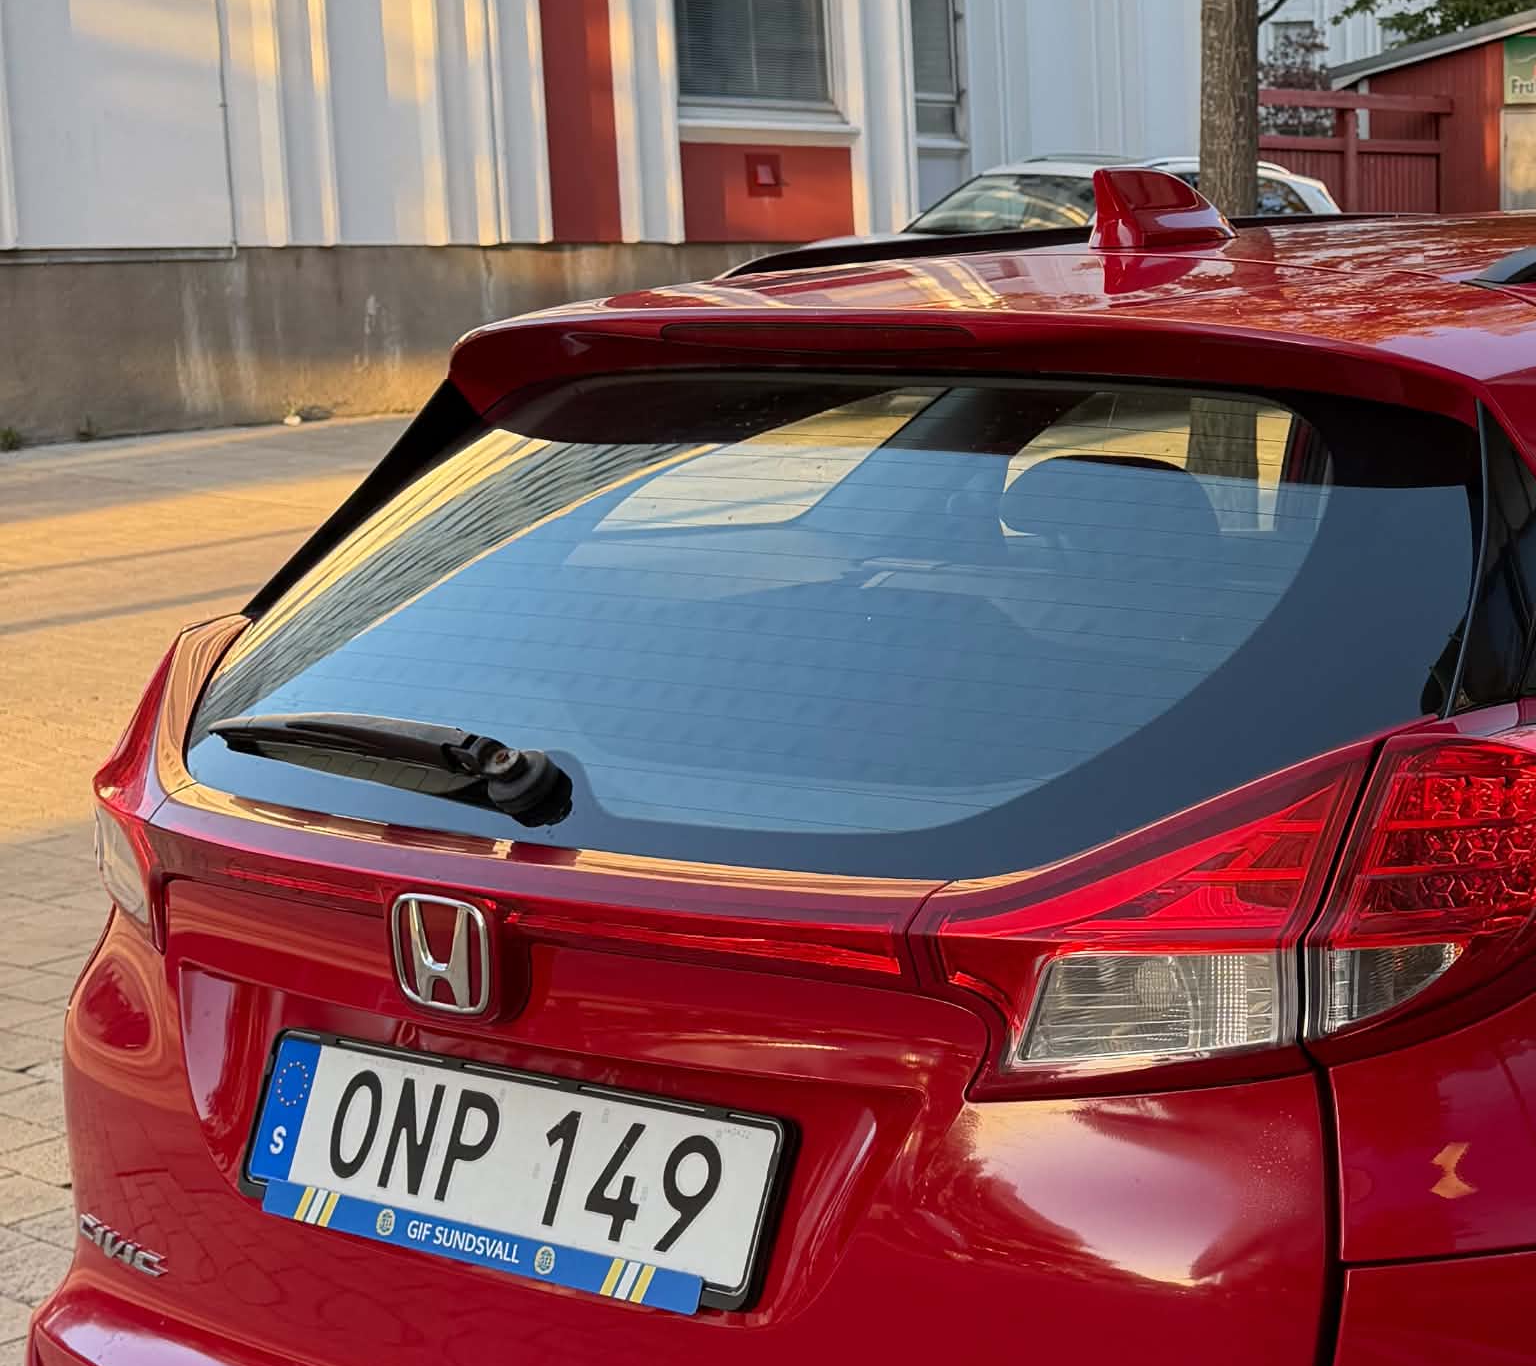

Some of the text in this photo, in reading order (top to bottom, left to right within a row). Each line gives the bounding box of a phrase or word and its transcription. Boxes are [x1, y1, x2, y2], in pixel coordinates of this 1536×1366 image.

[269, 1125, 288, 1155] S
[329, 1069, 722, 1253] ONP 149
[80, 1213, 163, 1277] CIVIC
[406, 1220, 520, 1264] GIF SUNDSVALL
